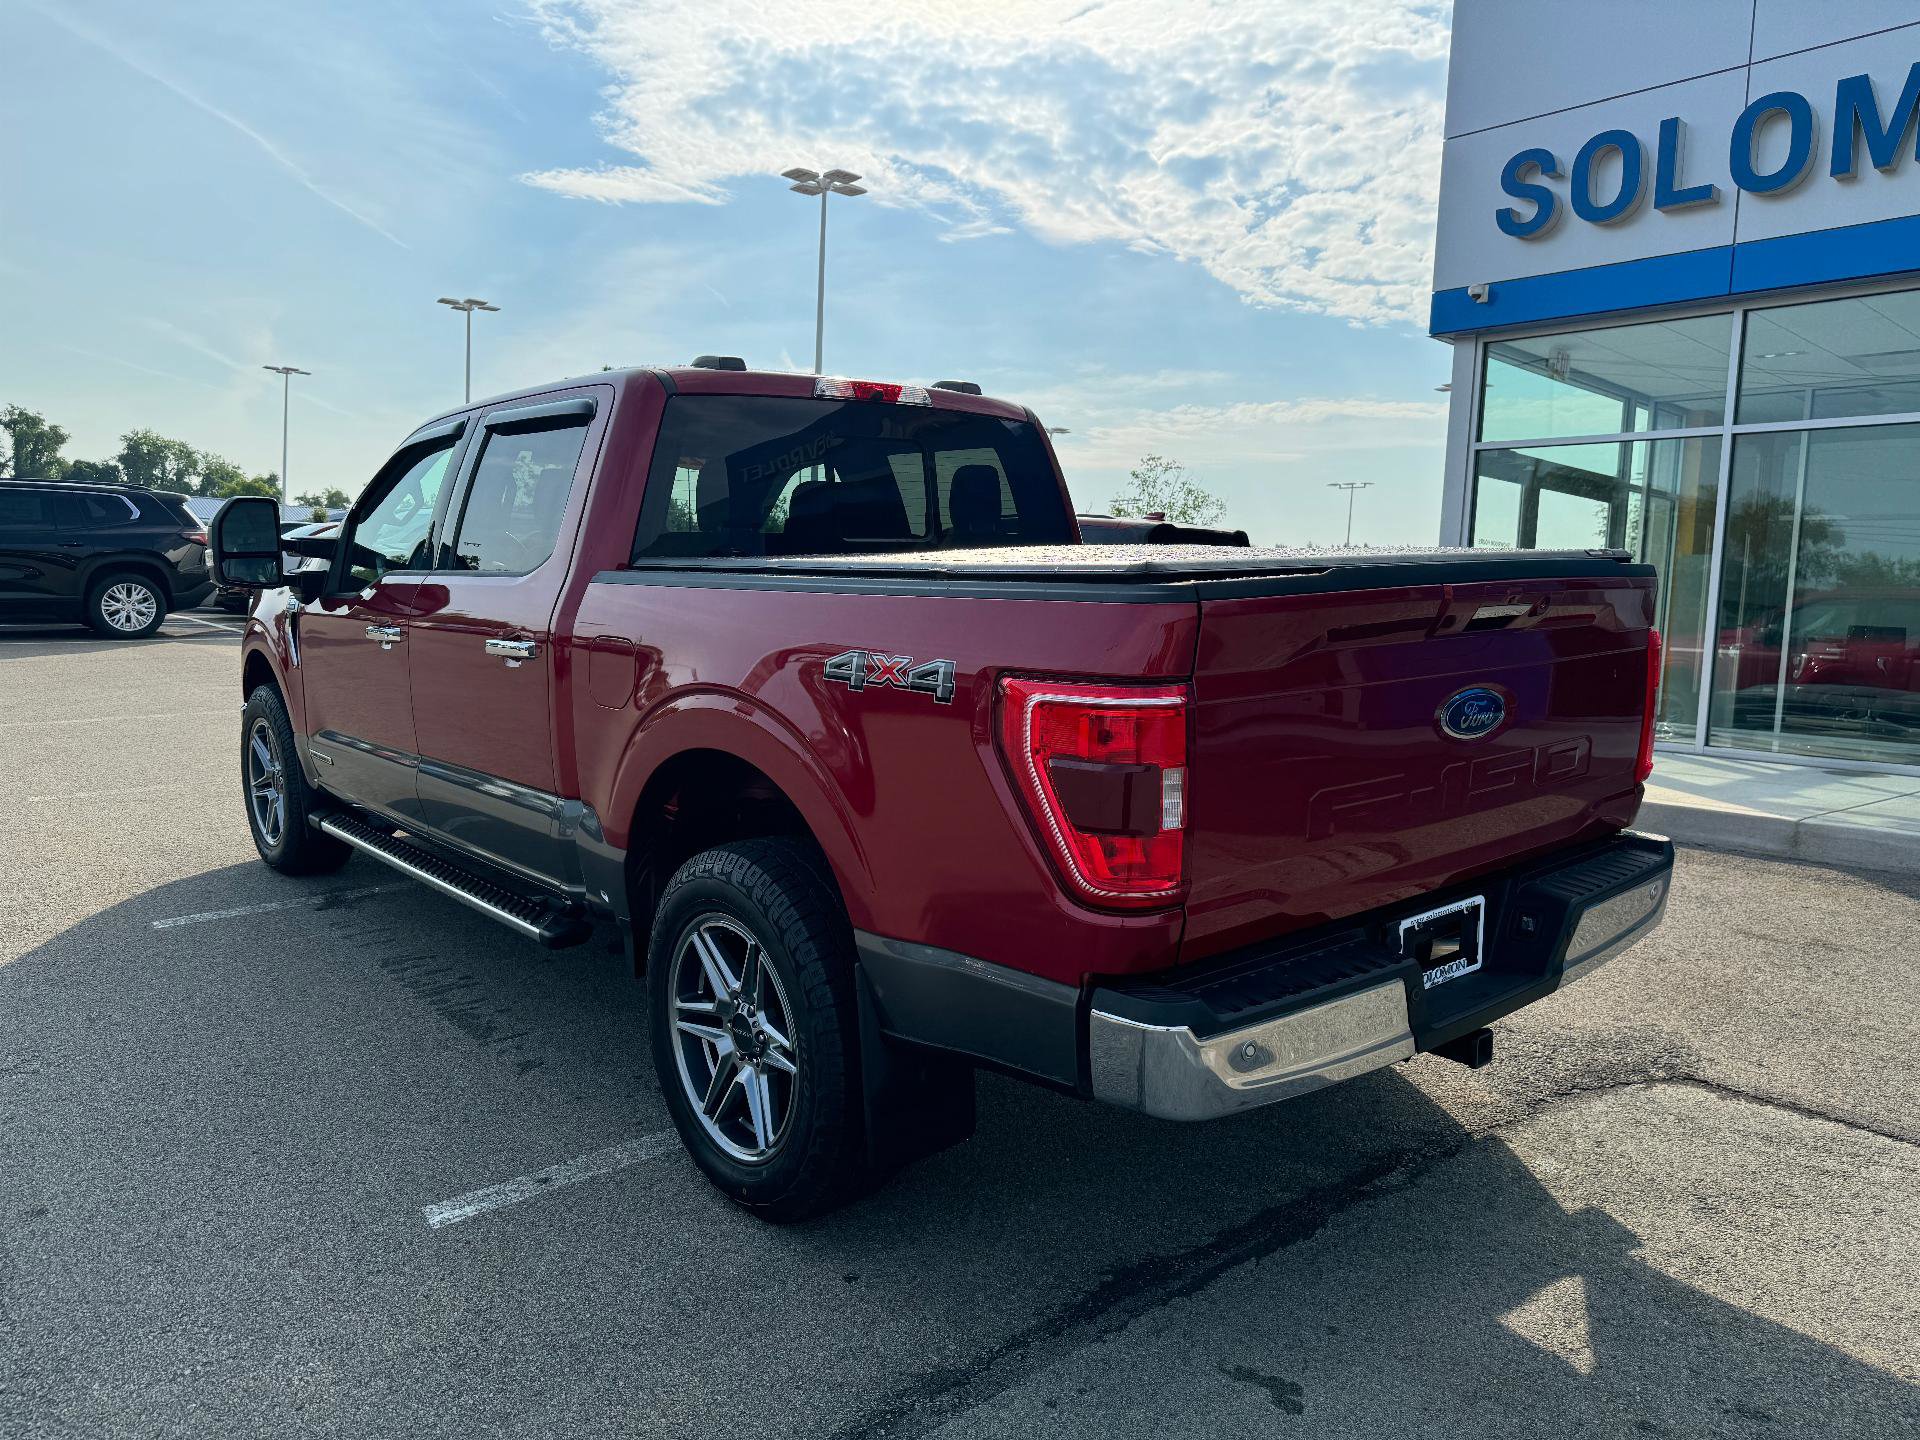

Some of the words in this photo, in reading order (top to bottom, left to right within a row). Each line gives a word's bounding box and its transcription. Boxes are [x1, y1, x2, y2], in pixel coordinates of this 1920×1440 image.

[1496, 62, 1920, 240] SOLOM
[1461, 700, 1495, 729] Ford
[1304, 734, 1592, 841] F-150
[1423, 959, 1467, 985] OLOMON
